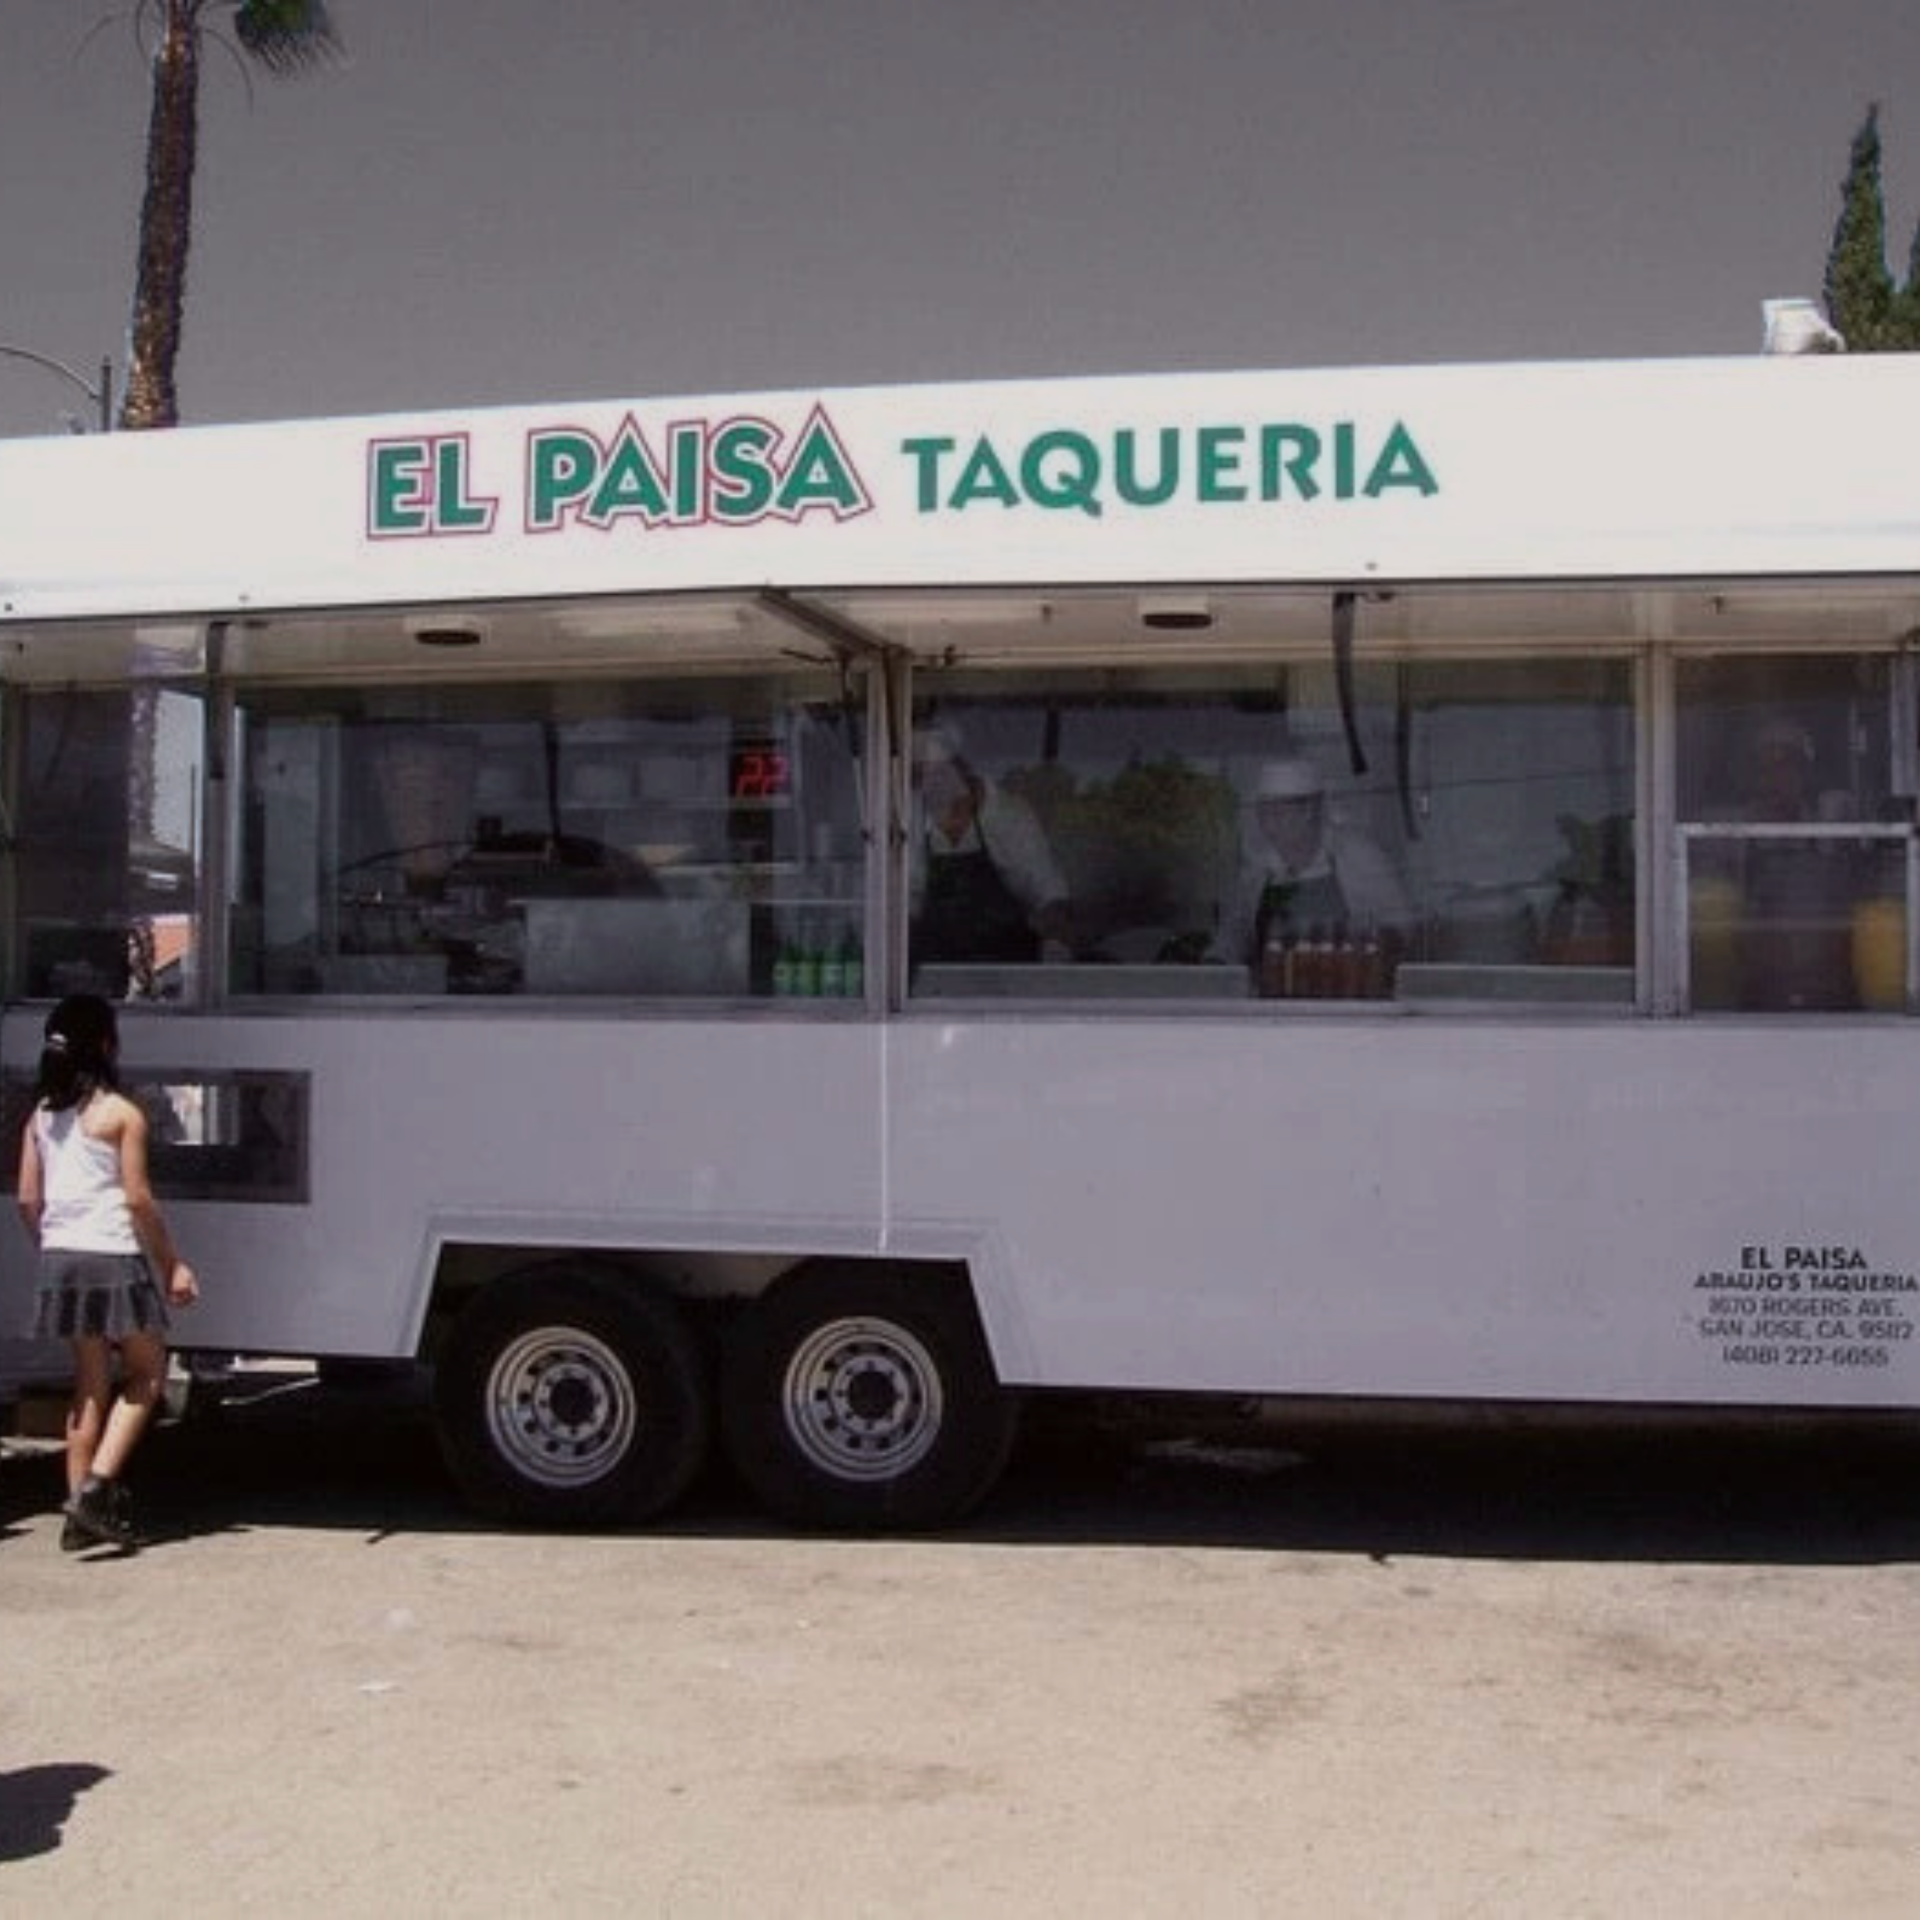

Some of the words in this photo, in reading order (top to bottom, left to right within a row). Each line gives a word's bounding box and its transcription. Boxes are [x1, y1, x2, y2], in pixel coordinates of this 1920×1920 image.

[366, 432, 499, 540] EL
[523, 400, 876, 534] PAISA
[901, 419, 1440, 517] TAQUERIA
[1741, 1247, 1772, 1269] EL
[1785, 1247, 1867, 1269] PAISA
[1809, 1274, 1919, 1292] TAQUERIA
[1762, 1298, 1851, 1317] ROGERS
